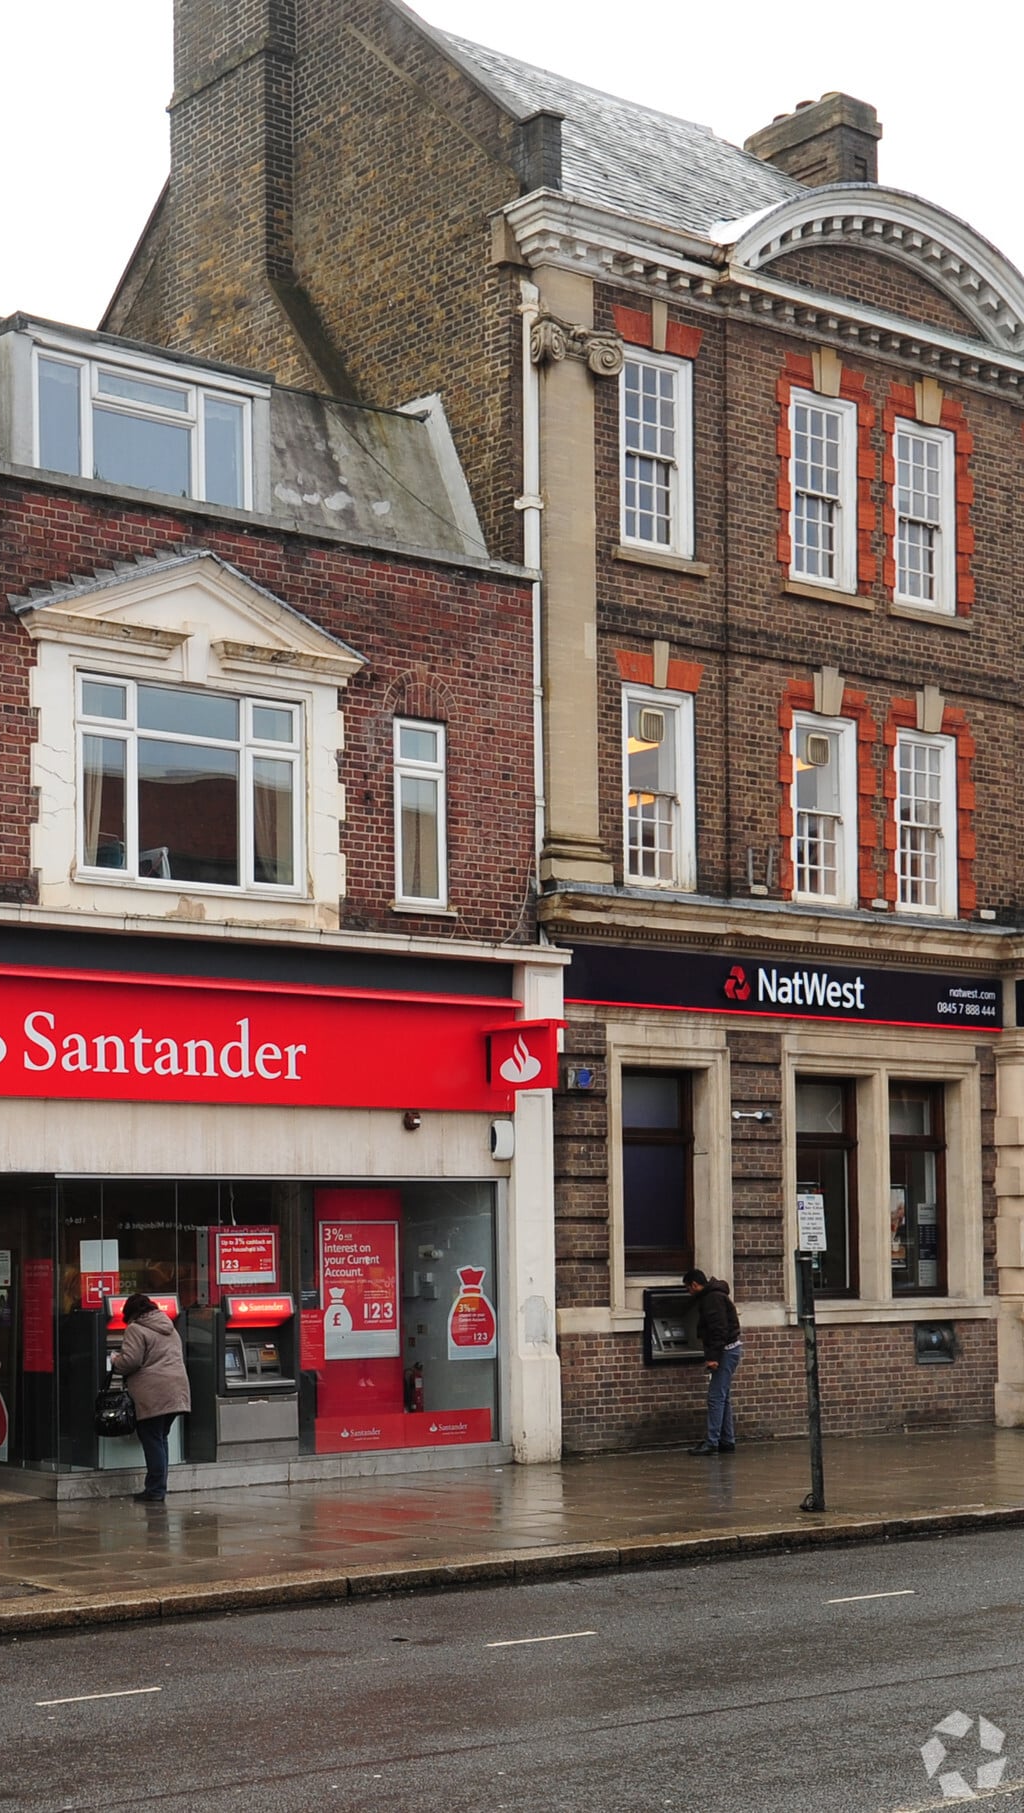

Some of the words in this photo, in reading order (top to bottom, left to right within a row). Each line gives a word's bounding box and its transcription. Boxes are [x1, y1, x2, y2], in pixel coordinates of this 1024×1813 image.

[758, 967, 865, 1010] NatWest
[949, 987, 996, 1001] natwest.com
[937, 1001, 957, 1014] 0845
[958, 1003, 964, 1014] 7
[965, 1003, 980, 1015] 888
[981, 1004, 996, 1016] 444
[23, 1010, 307, 1080] Santander
[324, 1228, 344, 1241] 3%
[324, 1243, 357, 1253] interest
[359, 1245, 371, 1253] on
[324, 1256, 345, 1268] your
[347, 1255, 380, 1264] Current
[324, 1267, 363, 1277] Account.
[248, 1302, 284, 1311] Santander
[363, 1302, 393, 1319] 123
[473, 1332, 488, 1340] 123
[350, 1427, 381, 1436] Santander
[438, 1422, 468, 1431] Santander
